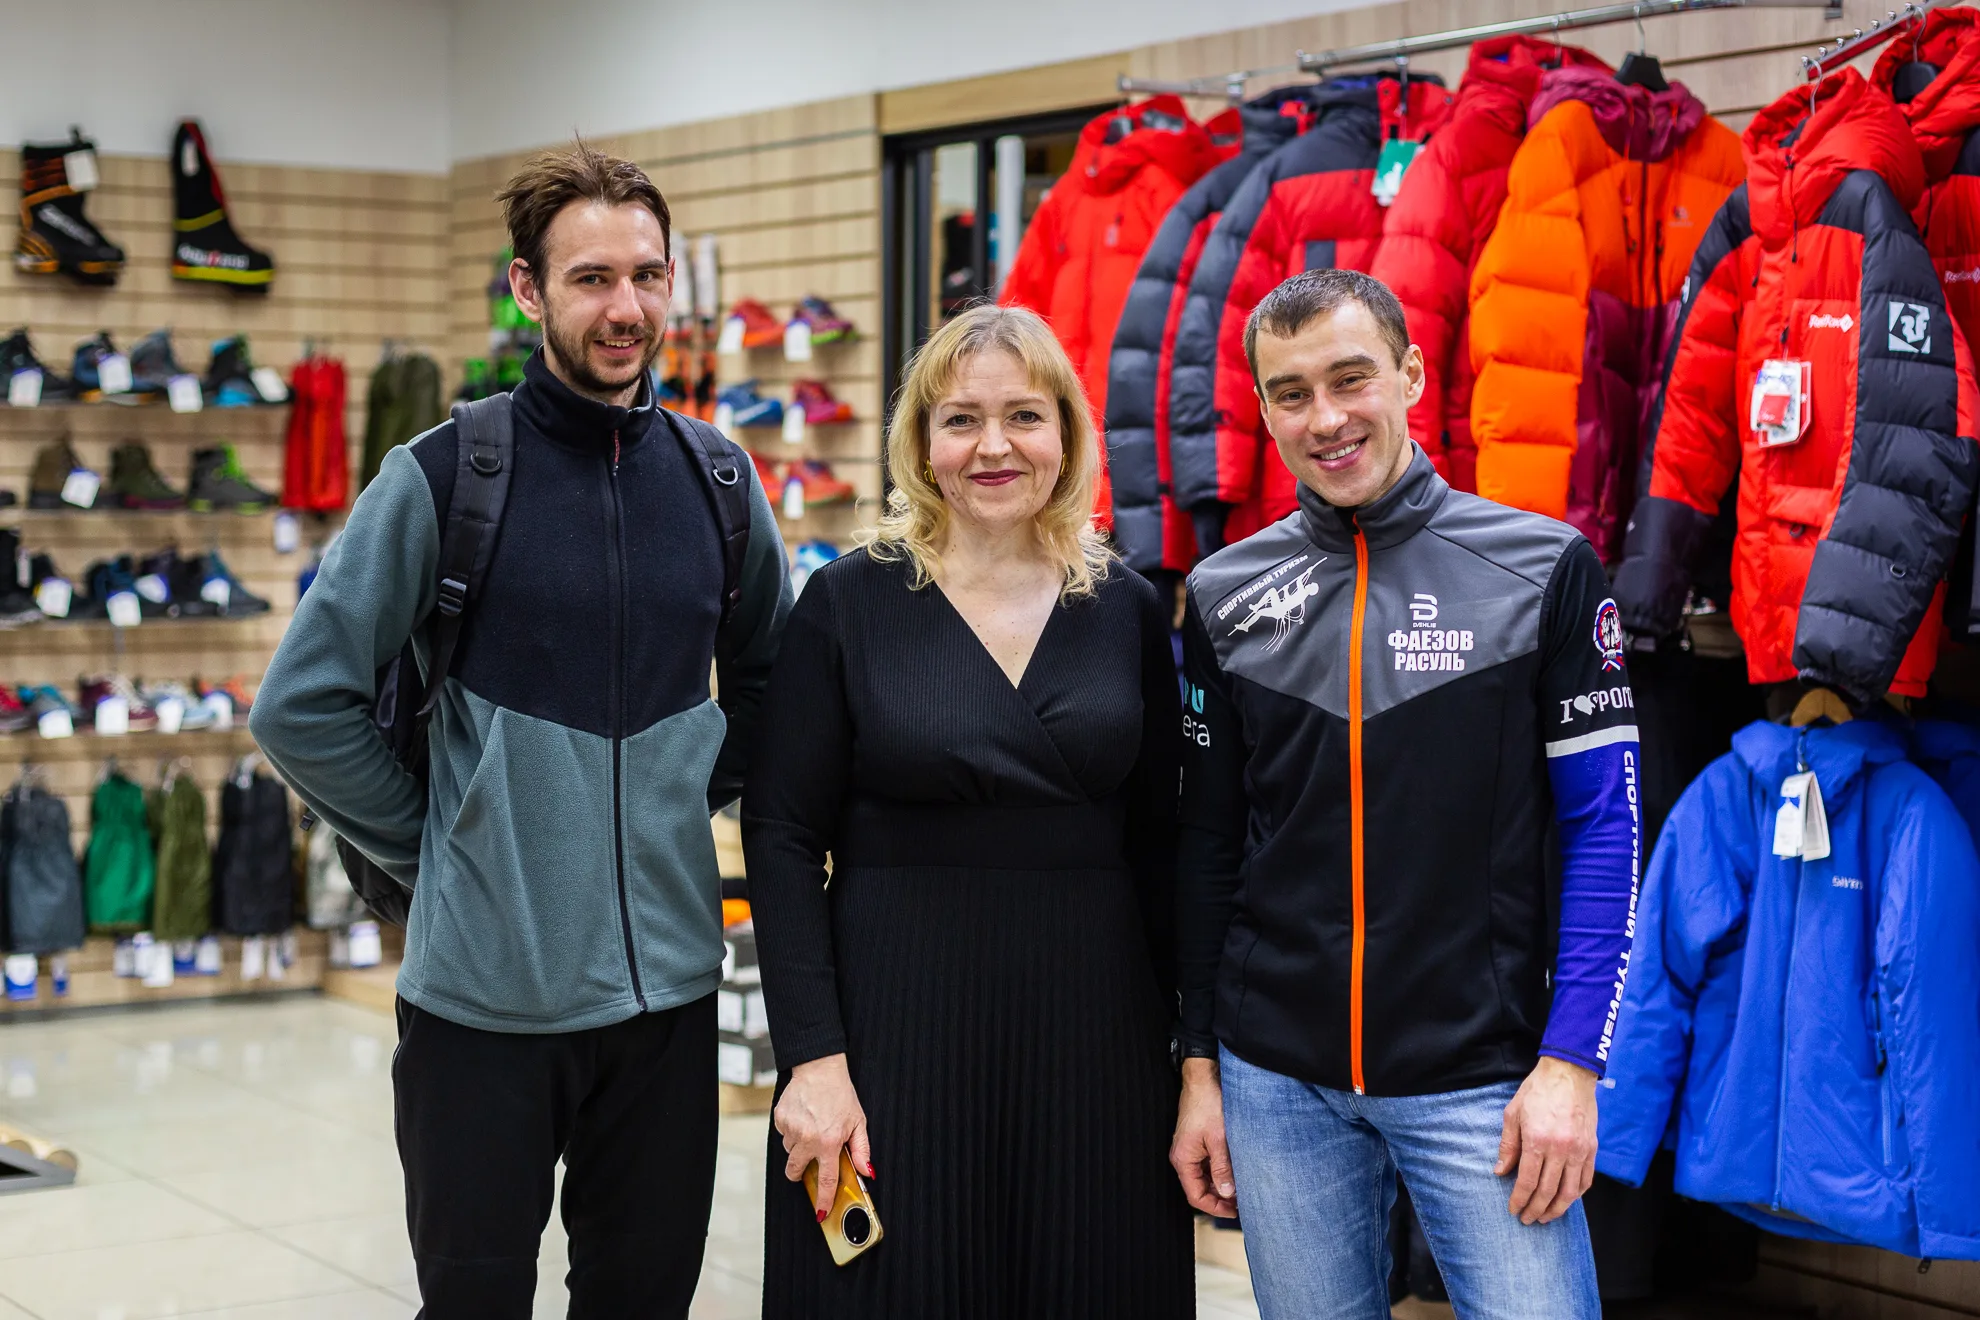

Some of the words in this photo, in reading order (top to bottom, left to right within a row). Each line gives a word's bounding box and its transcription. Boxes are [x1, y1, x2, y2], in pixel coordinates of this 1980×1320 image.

[1217, 573, 1275, 620] СПОРТИВНЫЙ
[1273, 555, 1308, 579] ТУРИЗМ
[1388, 630, 1474, 651] ФАЕЗОВ
[1395, 652, 1465, 671] РАСУЛЬ
[1596, 949, 1632, 1061] ТУРИЗМ
